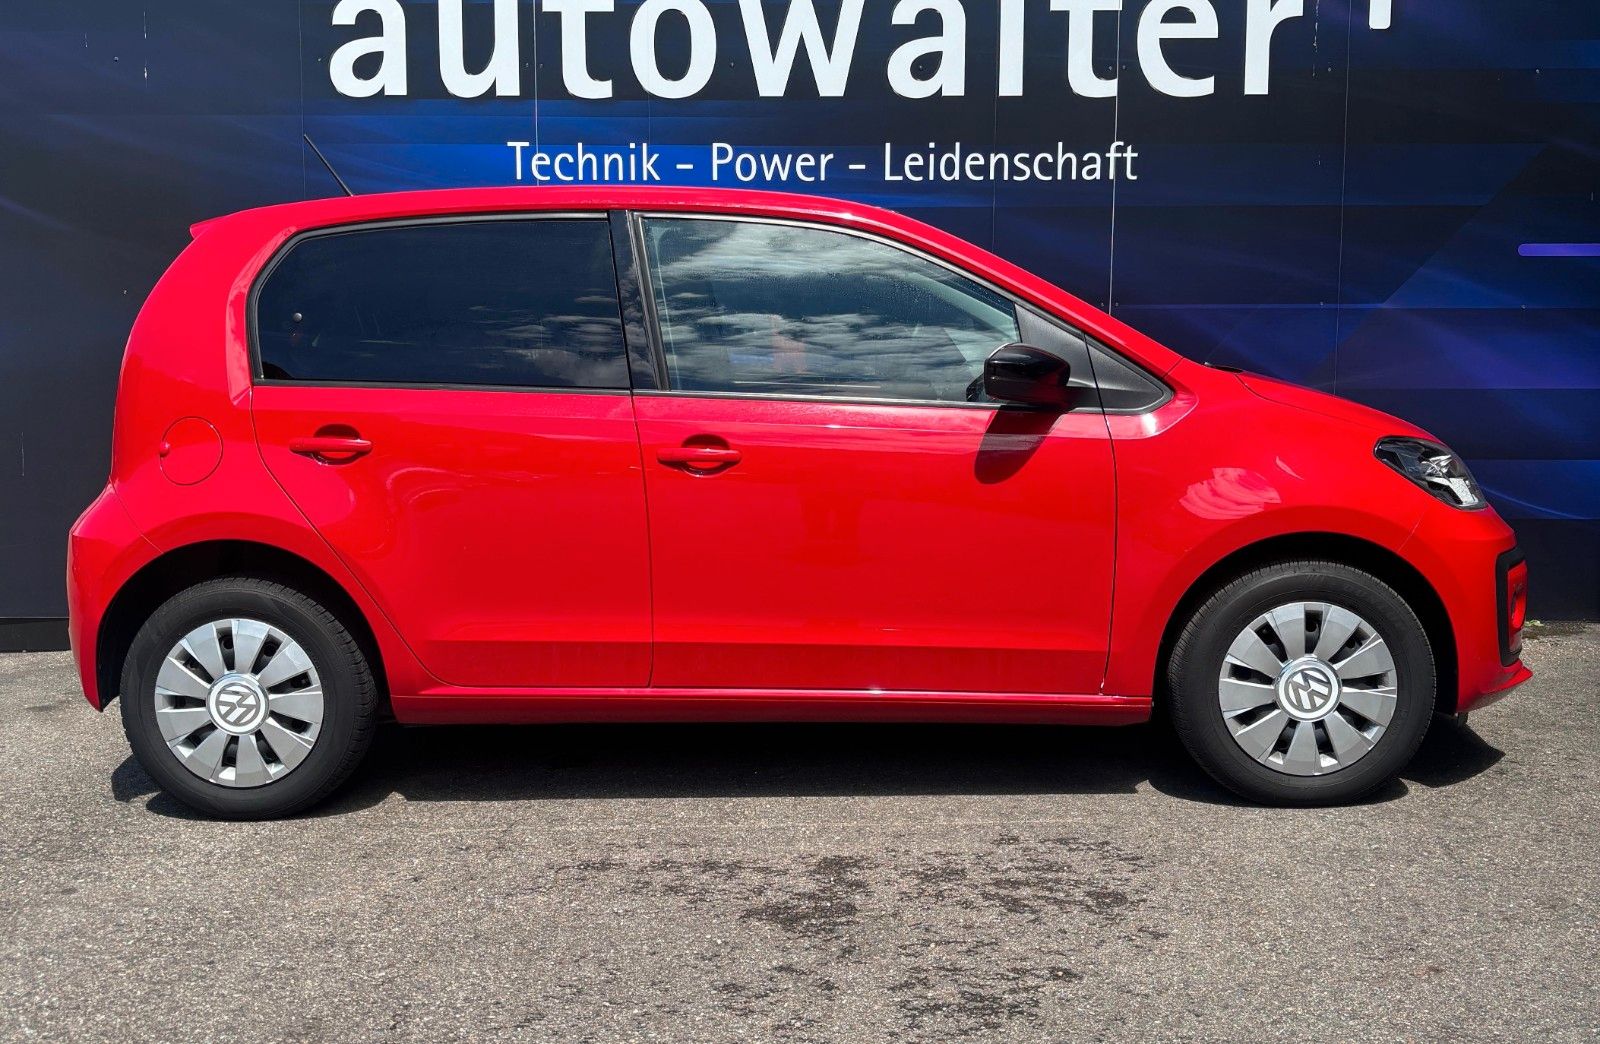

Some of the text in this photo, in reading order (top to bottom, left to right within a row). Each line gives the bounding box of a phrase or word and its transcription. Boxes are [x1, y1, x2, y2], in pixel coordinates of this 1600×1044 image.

[507, 141, 661, 181] Technik
[712, 142, 834, 182] Power
[884, 140, 1139, 182] Leidenschaft
